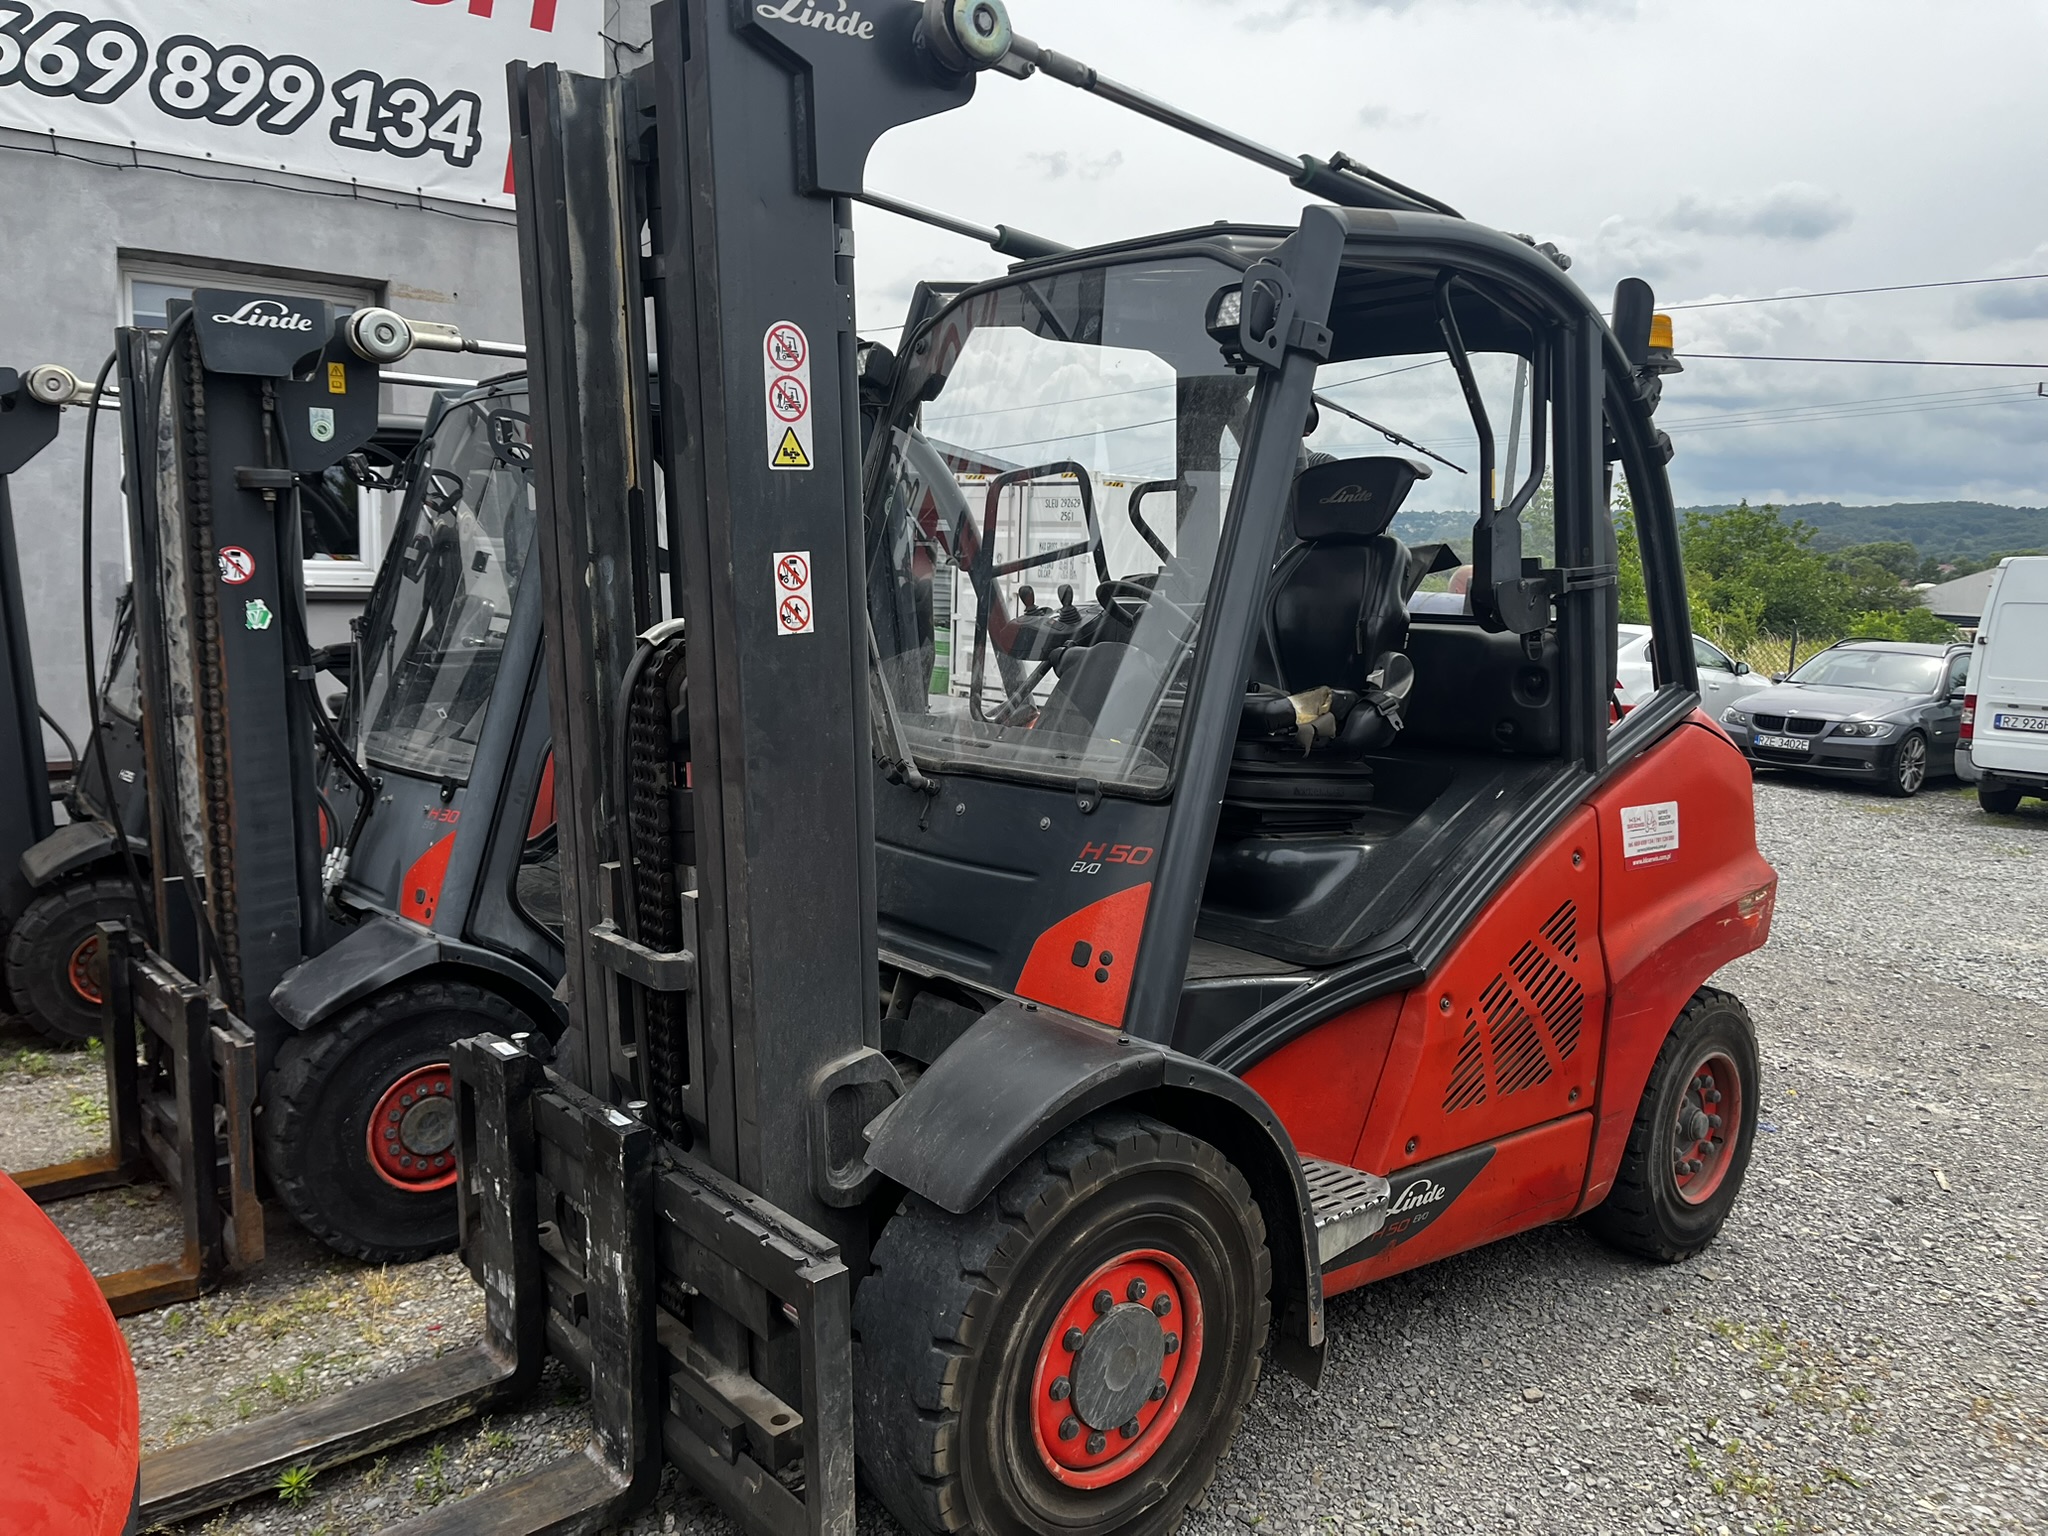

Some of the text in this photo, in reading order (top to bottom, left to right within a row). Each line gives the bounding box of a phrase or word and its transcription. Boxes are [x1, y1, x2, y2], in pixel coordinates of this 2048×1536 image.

[756, 0, 874, 39] Linde
[152, 37, 322, 133] 899
[331, 71, 481, 167] 134
[211, 300, 313, 331] Linde
[1319, 484, 1373, 504] Linde
[2002, 716, 2019, 728] RZ
[1759, 735, 1808, 751] RZE 3402E
[1070, 861, 1102, 874] EVO
[1385, 1179, 1446, 1217] Linde
